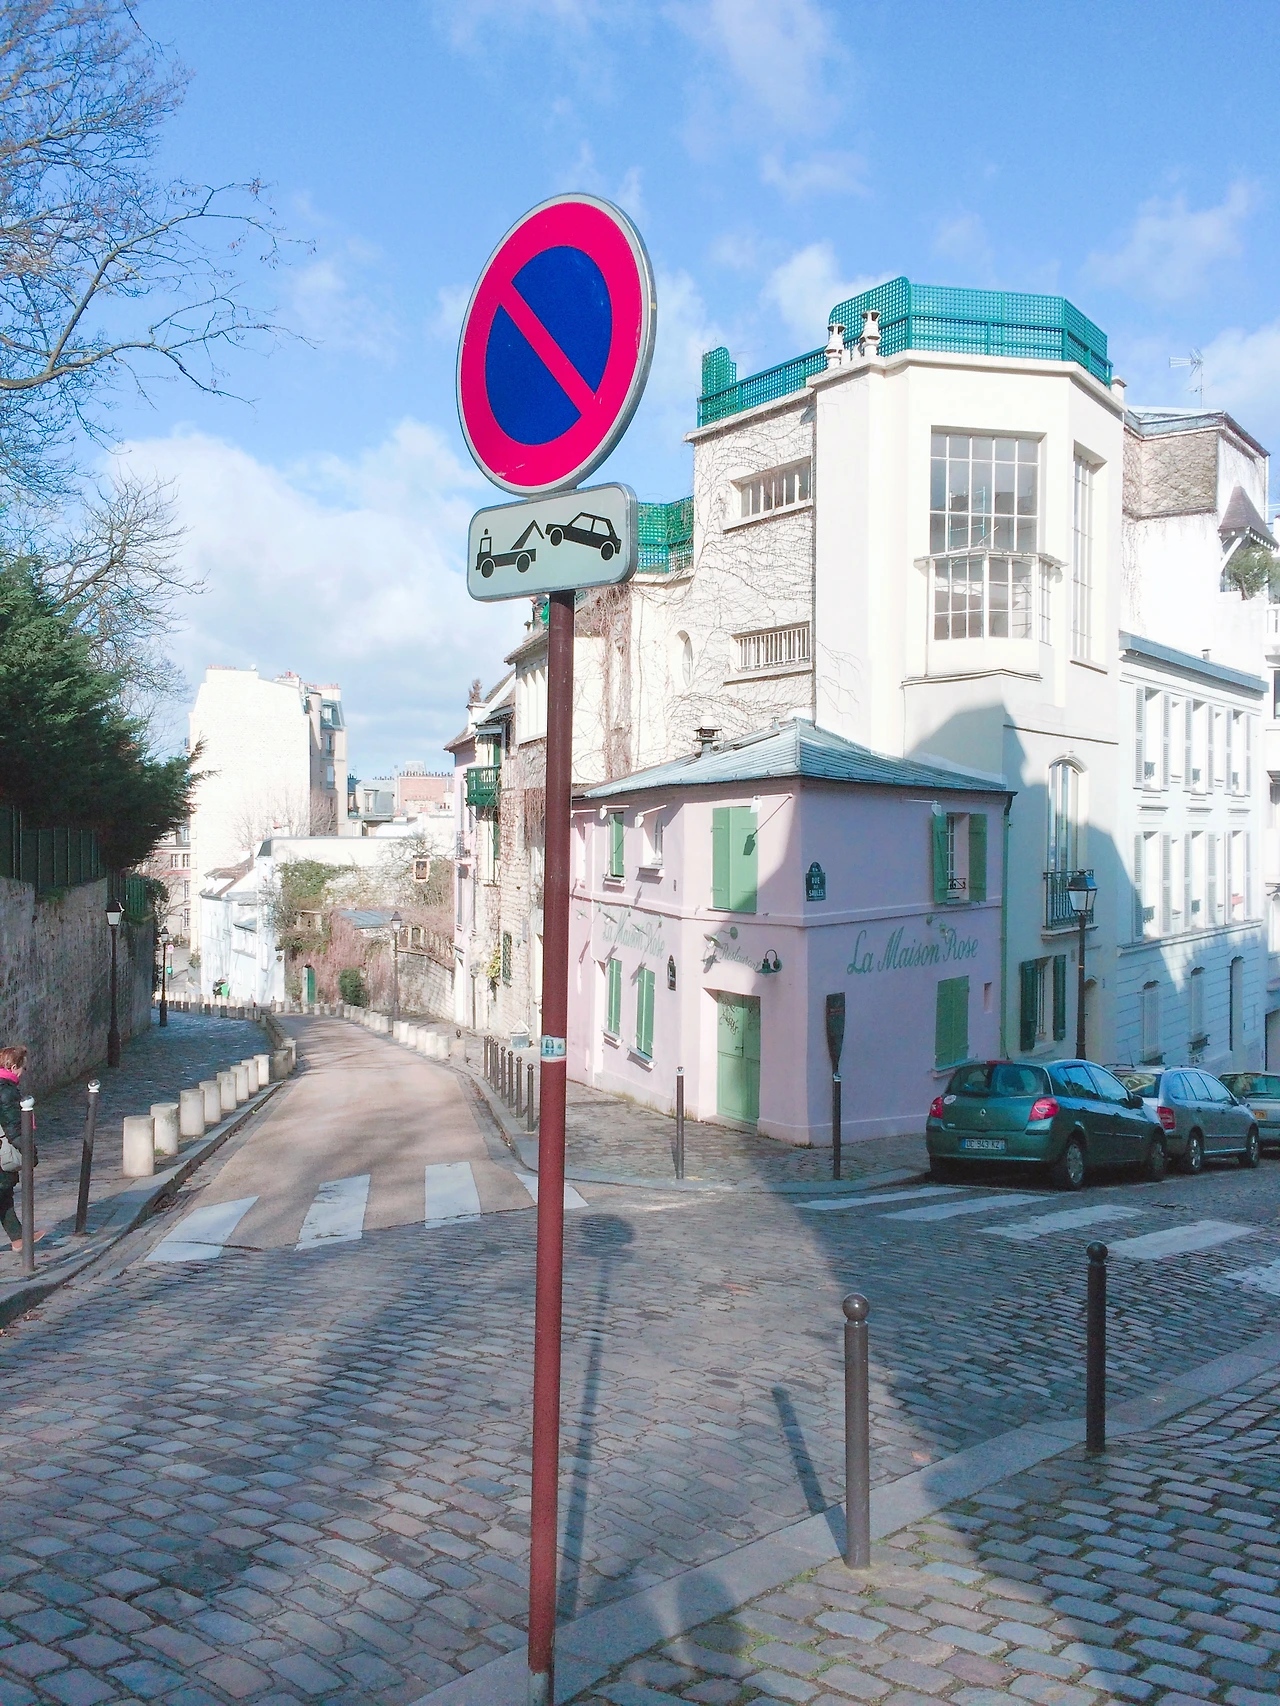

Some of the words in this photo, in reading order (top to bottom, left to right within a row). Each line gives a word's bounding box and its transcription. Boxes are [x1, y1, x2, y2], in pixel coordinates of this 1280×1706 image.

[720, 942, 762, 971] Restaurant
[847, 929, 874, 975] La
[877, 926, 940, 971] Maison
[943, 927, 979, 962] Rose
